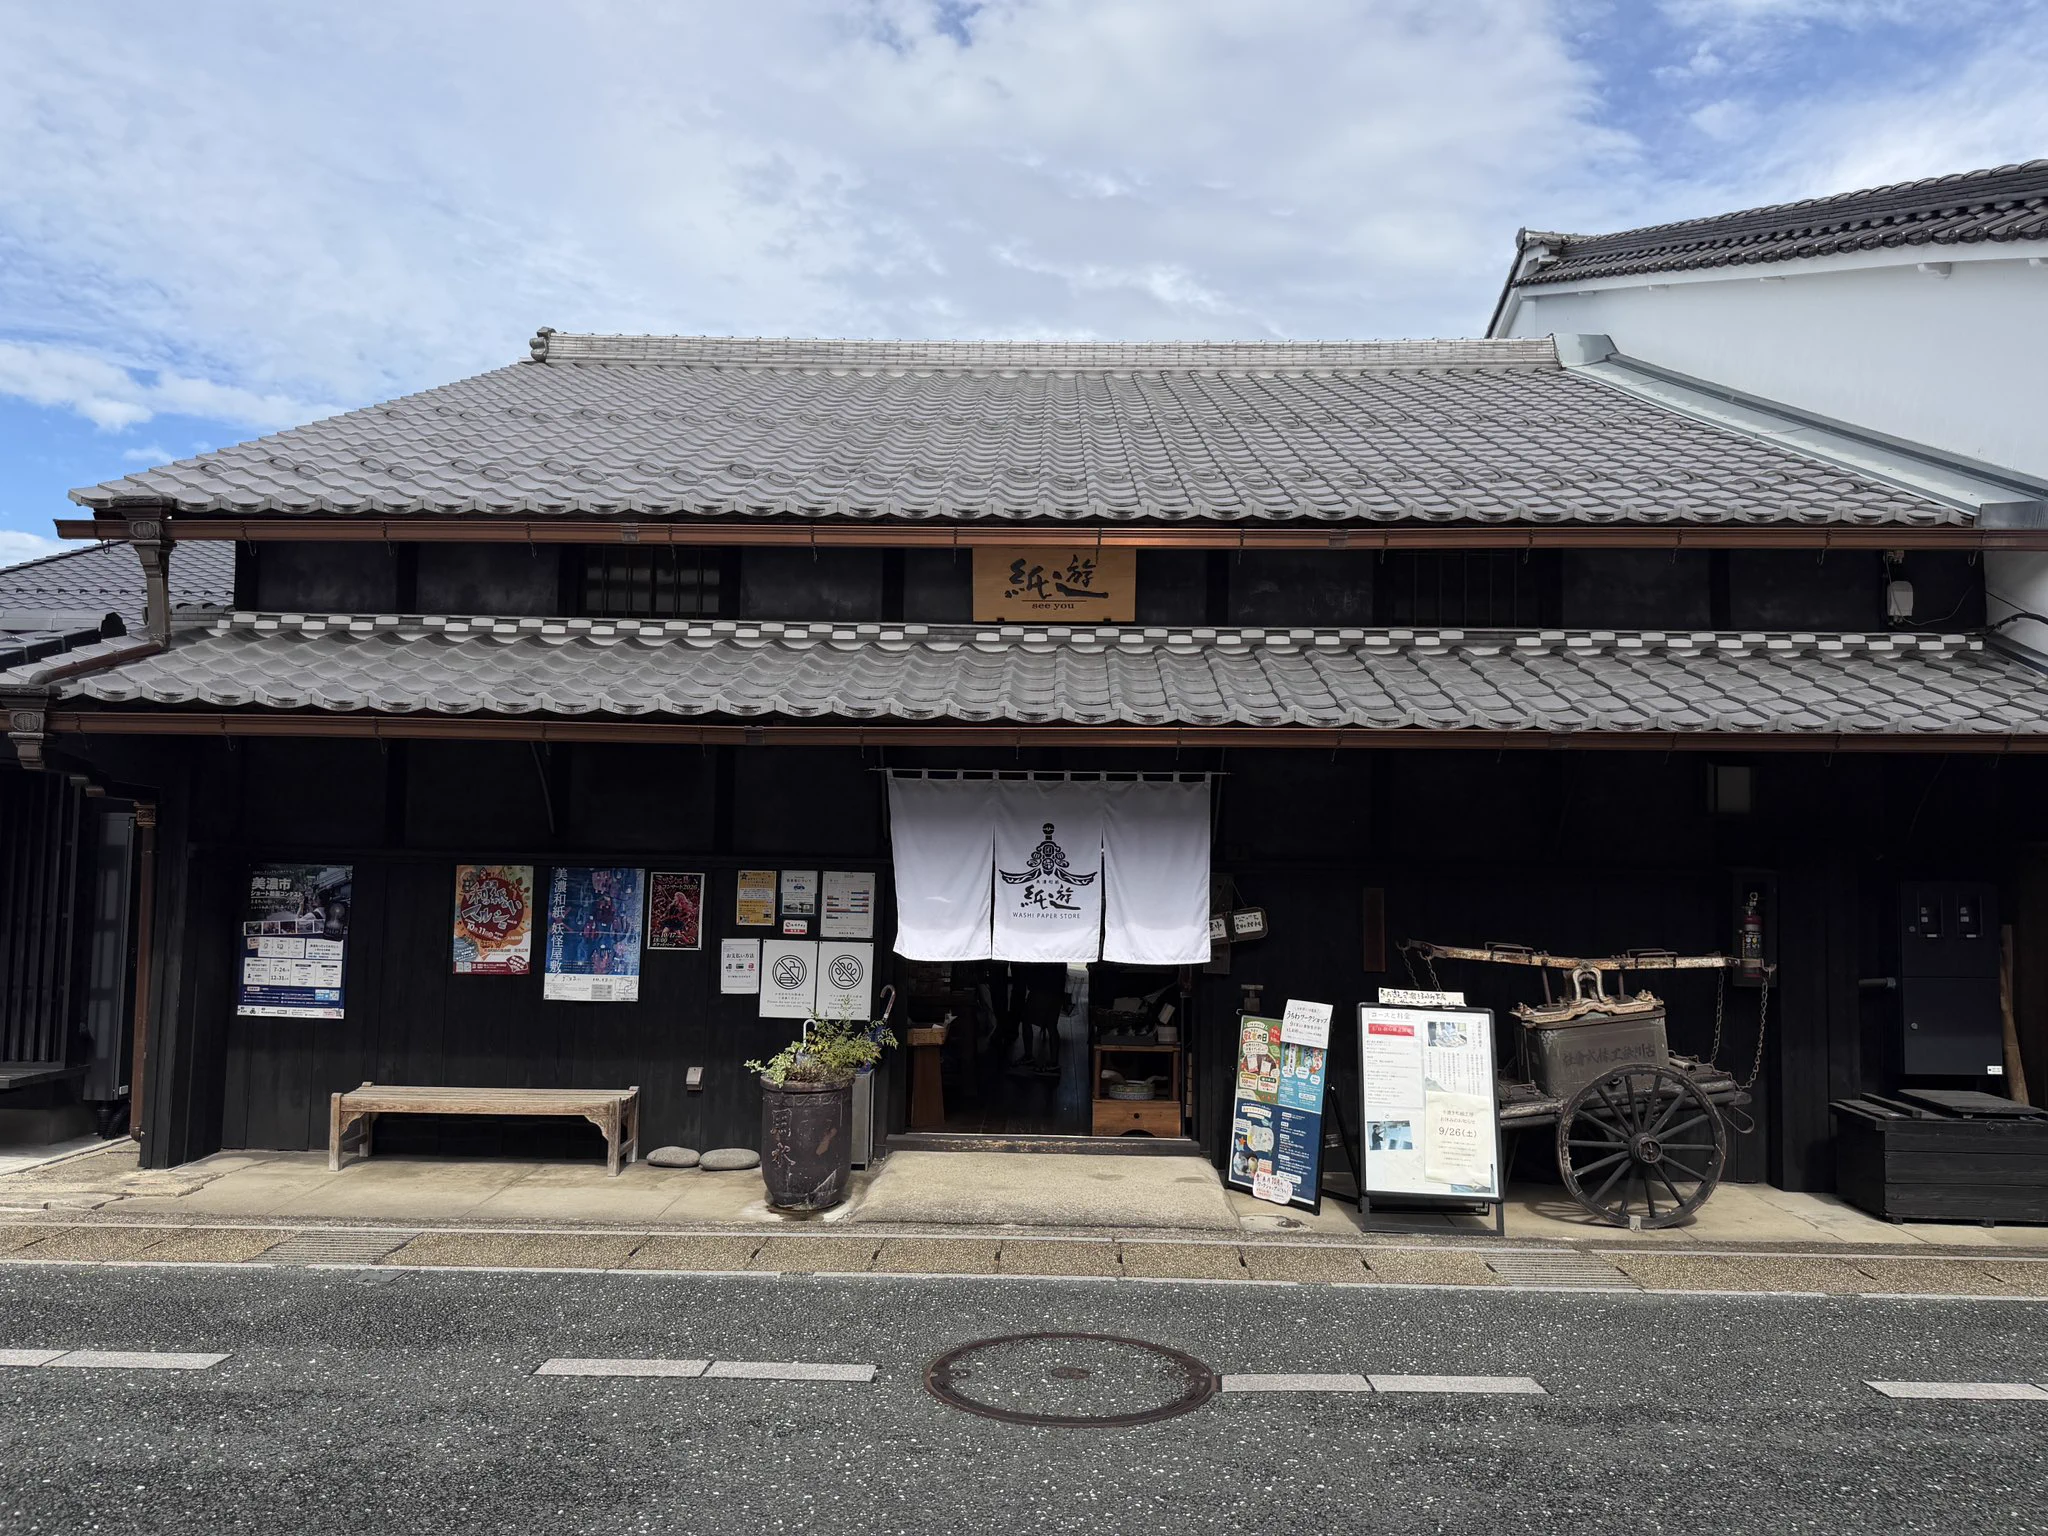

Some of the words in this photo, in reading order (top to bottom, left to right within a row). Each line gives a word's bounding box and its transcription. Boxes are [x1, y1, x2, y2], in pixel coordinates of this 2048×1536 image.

[1005, 554, 1109, 600] 紙遊
[1053, 603, 1075, 611] you
[251, 877, 292, 890] 美濃市
[551, 867, 568, 919] 美濃和紙
[1020, 884, 1081, 910] 紙遊
[549, 922, 565, 979] 妖怪屋敷
[1286, 1010, 1329, 1024] うちわワークショップ
[1438, 1126, 1478, 1138] 9/26(土)
